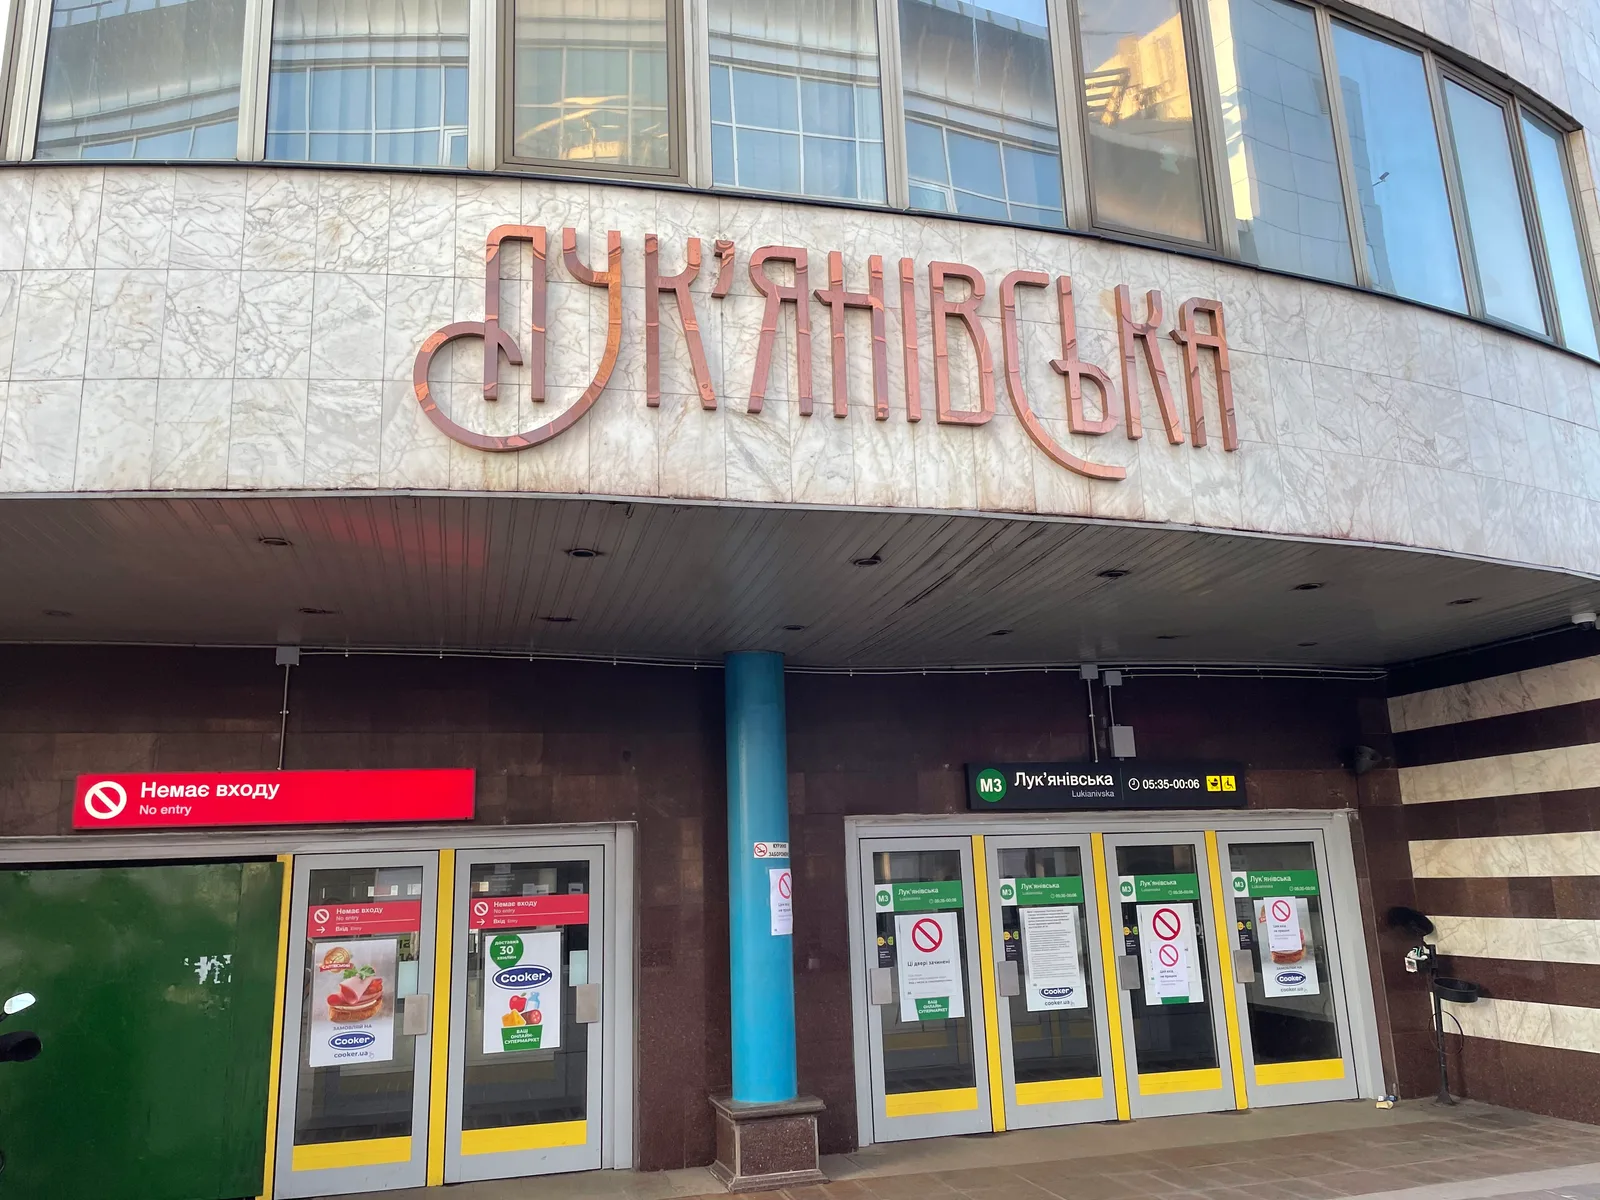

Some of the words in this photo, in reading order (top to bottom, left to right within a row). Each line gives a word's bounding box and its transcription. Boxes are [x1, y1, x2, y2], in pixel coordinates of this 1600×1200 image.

[1014, 772, 1114, 788] Лук'янівська
[1142, 778, 1200, 790] 05:35-00:06
[140, 781, 210, 798] Немає
[216, 782, 280, 800] входу
[1072, 789, 1114, 798] Lukianivska
[139, 804, 157, 816] No
[160, 804, 192, 817] entry
[1250, 875, 1291, 883] Лук'янівська
[898, 888, 938, 896] Лук'янівська
[499, 946, 514, 955] 30
[501, 972, 546, 983] Cooker
[1044, 987, 1070, 995] Cooker
[334, 1035, 370, 1045] Cooker
[504, 1037, 540, 1045] СУПЕРМАРКЕТ
[334, 1051, 368, 1059] cooker.ua
